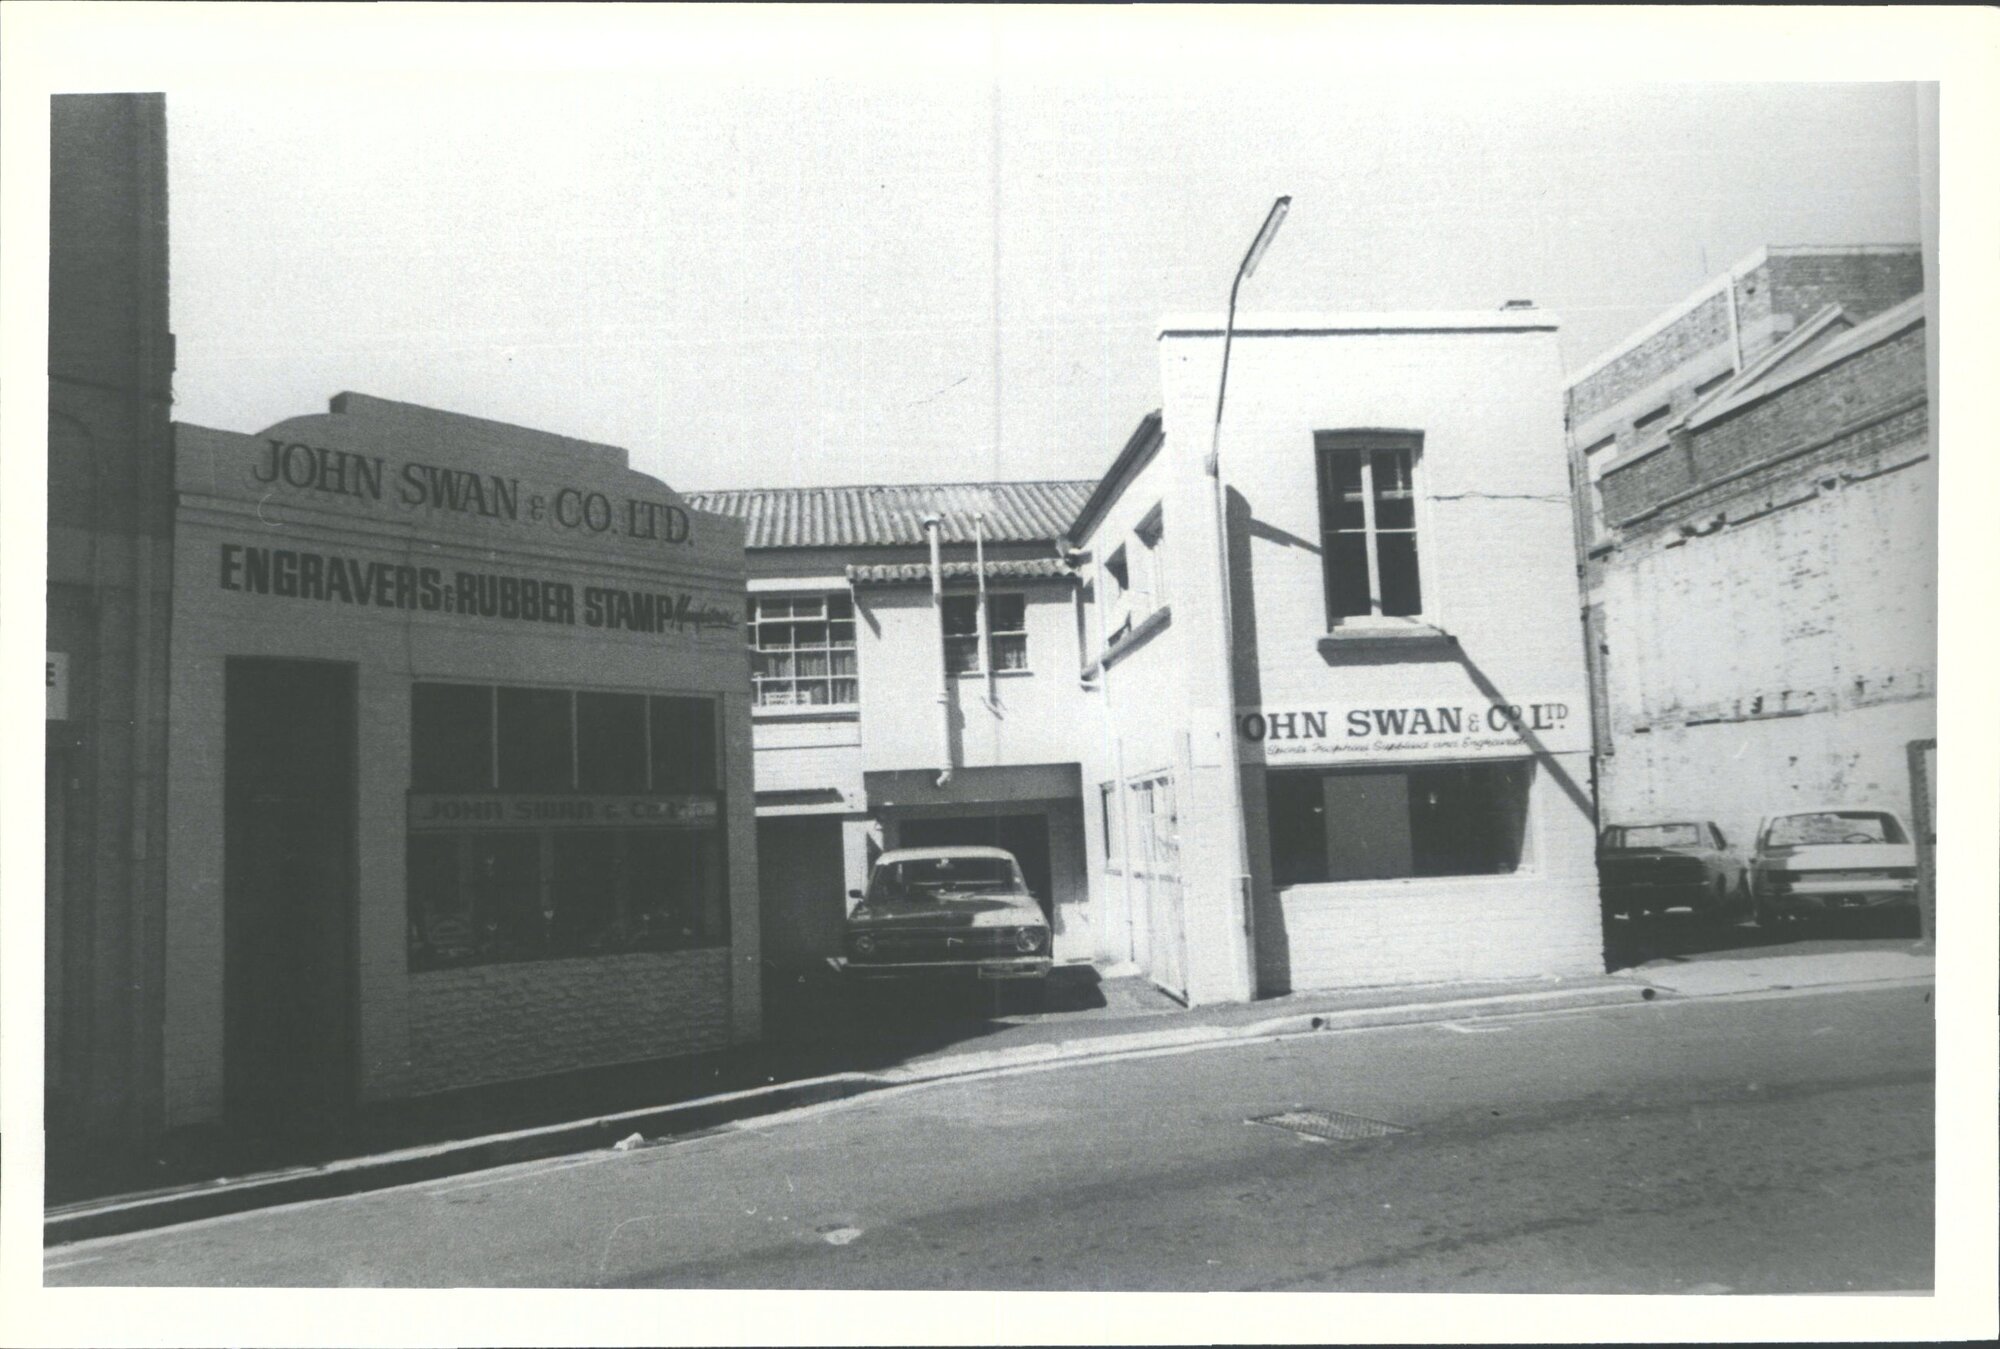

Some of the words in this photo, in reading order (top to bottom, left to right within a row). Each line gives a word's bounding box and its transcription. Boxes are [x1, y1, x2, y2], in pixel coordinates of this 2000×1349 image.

[253, 439, 385, 500] JOHN
[401, 462, 520, 521] SWAN
[530, 495, 546, 522] &
[555, 487, 618, 535] CO.
[627, 498, 694, 546] LTD.
[221, 543, 442, 611] ENGRAVERS
[455, 571, 576, 625] RUBBER
[584, 585, 673, 633] STAMP
[1346, 706, 1463, 737] SWAN
[1468, 713, 1480, 733] &
[1433, 739, 1458, 749] and
[421, 800, 504, 820] JOHN
[514, 800, 595, 819] SWAN
